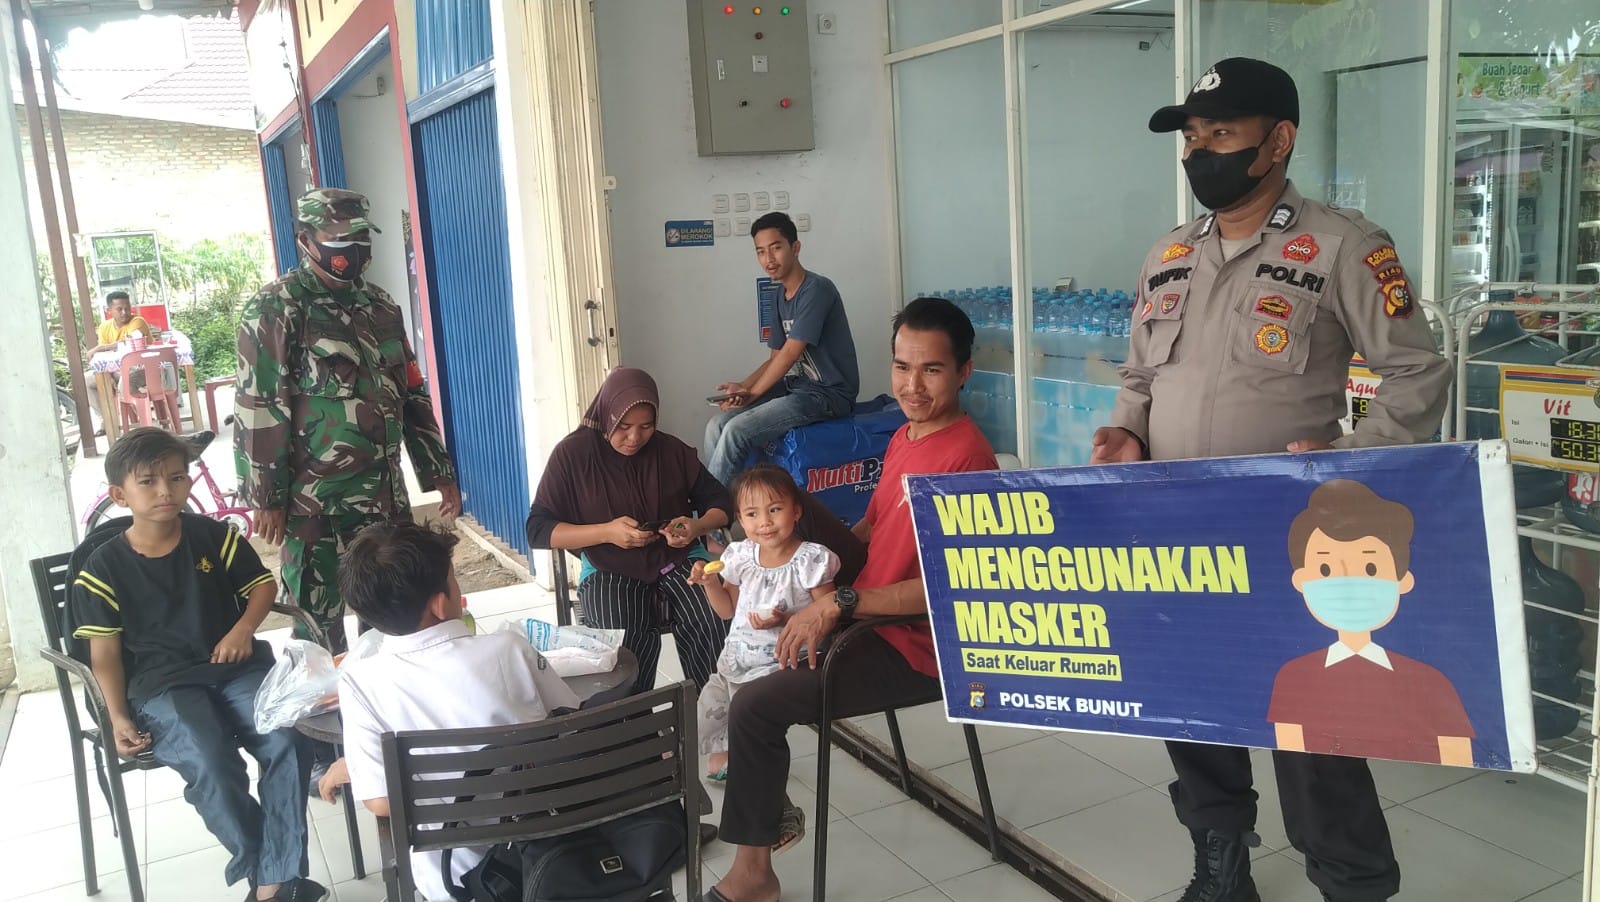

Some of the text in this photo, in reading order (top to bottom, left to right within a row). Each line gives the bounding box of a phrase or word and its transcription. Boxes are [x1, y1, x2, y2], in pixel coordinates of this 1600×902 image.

[1482, 63, 1505, 76] Buah
[1256, 263, 1325, 293] POLRI
[1543, 398, 1571, 415] Vit
[932, 491, 1056, 535] WAJIB
[944, 546, 1250, 594] MENGGUNAKAN
[953, 601, 1111, 648] MASKER
[966, 652, 1117, 676] Saat Keluar Rumah
[1000, 692, 1142, 717] POLSEK BUNUT
